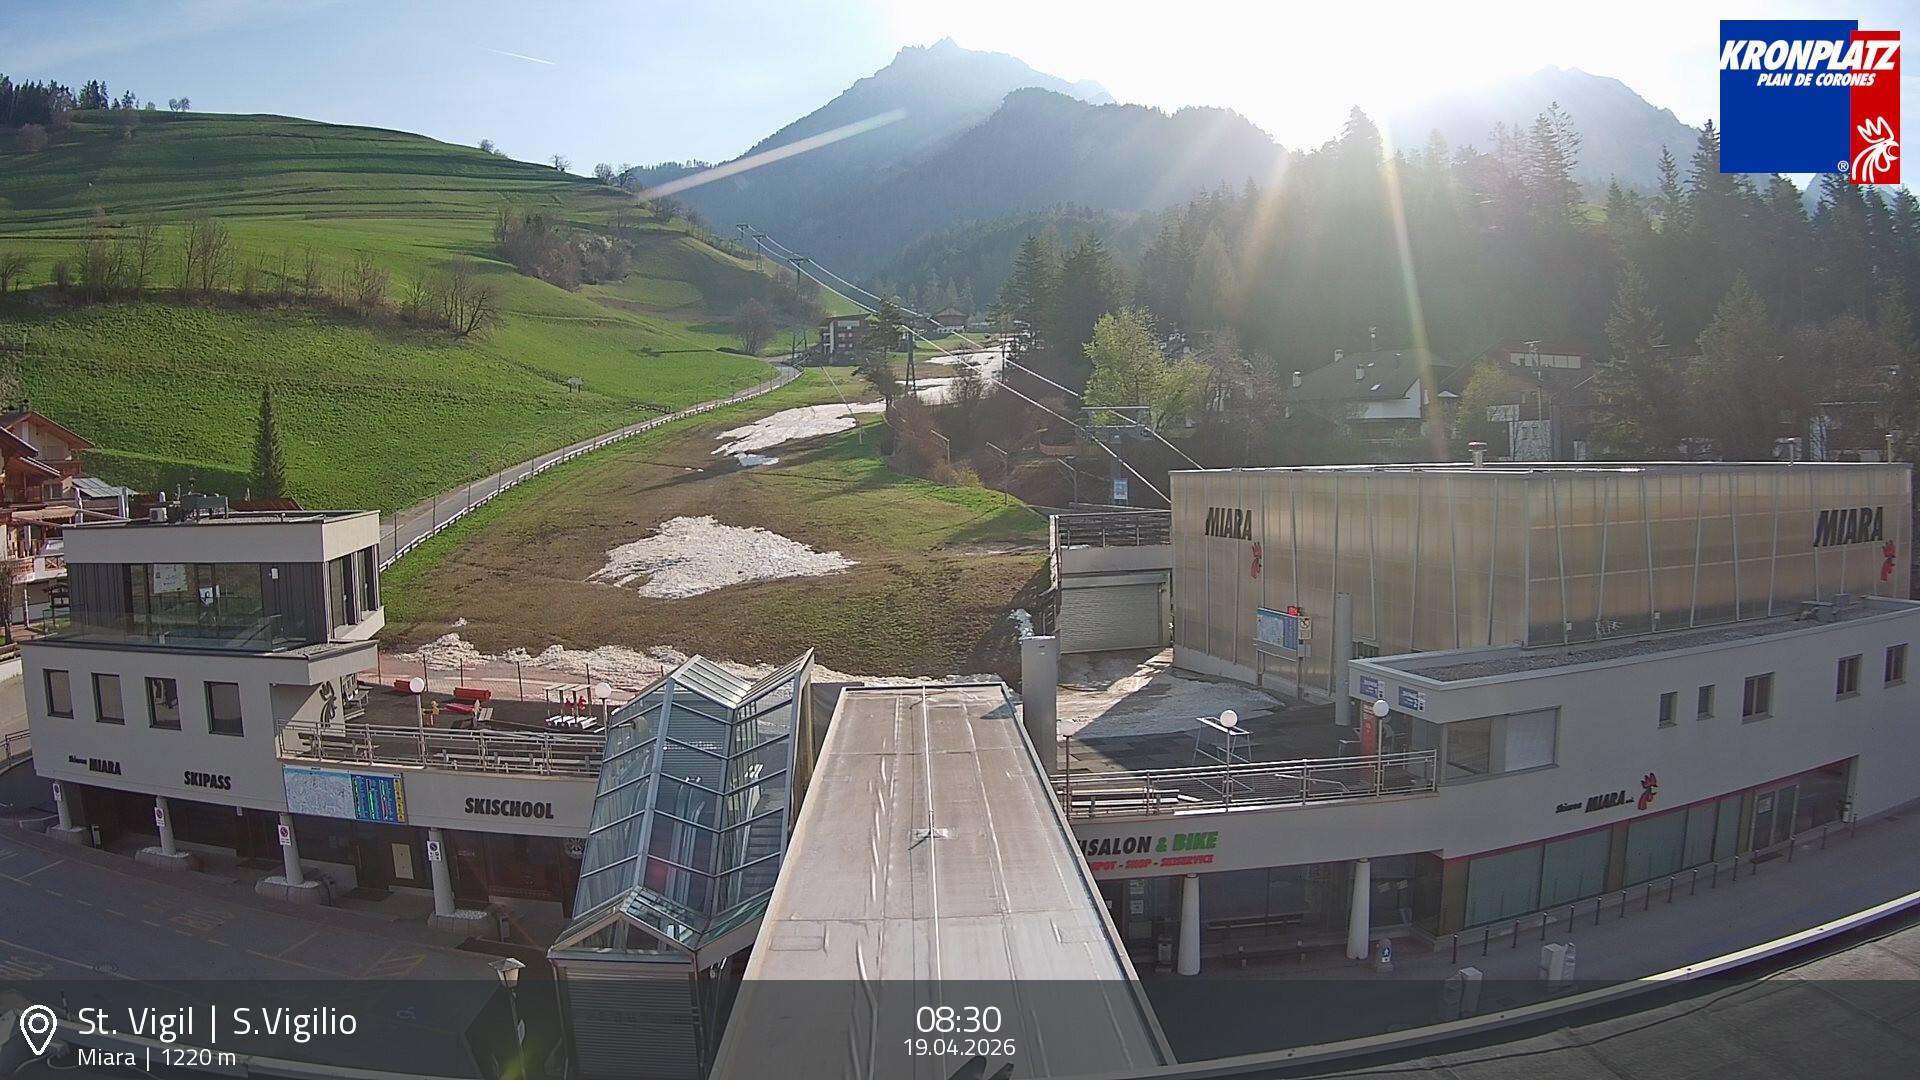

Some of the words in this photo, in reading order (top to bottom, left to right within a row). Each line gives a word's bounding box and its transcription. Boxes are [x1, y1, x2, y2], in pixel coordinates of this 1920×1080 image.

[1205, 507, 1252, 541] MIARA
[1813, 506, 1884, 547] MIARA
[89, 758, 121, 775] MIARA
[184, 771, 231, 790] SKIPASS
[465, 797, 554, 819] SKISCHOOL
[1585, 790, 1626, 813] MIARA
[1155, 838, 1167, 852] &
[1172, 831, 1218, 851] BIKE
